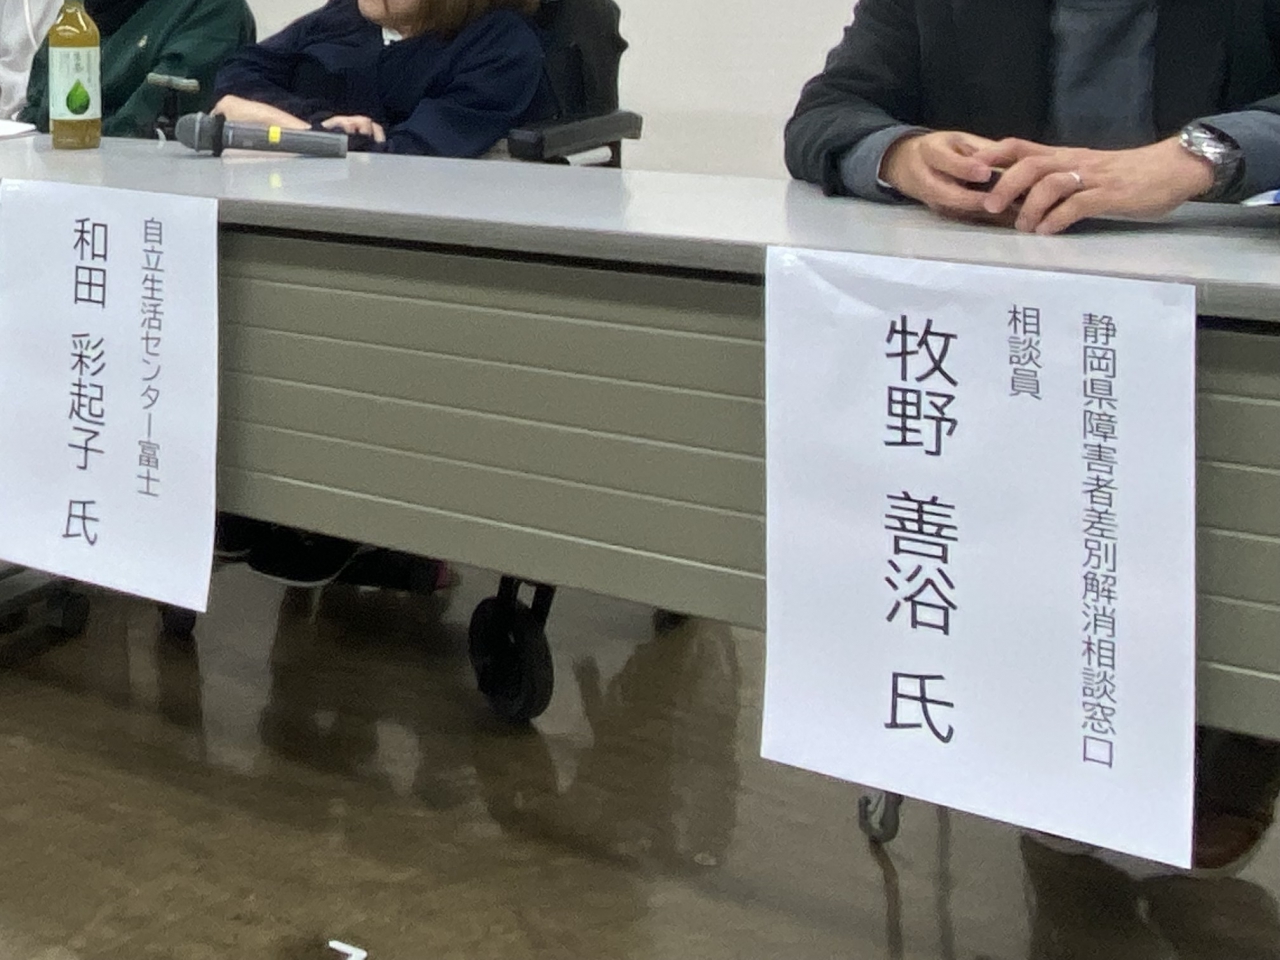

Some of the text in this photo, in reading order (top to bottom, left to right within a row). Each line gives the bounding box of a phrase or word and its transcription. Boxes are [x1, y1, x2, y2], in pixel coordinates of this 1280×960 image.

[62, 218, 108, 546] 和田 彩起子 氏
[136, 217, 164, 498] 自立生活センター富士
[1007, 304, 1042, 400] 相談員
[884, 315, 958, 744] 牧野 善浴 氏
[1082, 312, 1118, 769] 静岡県障害者差別解消相談窓口
